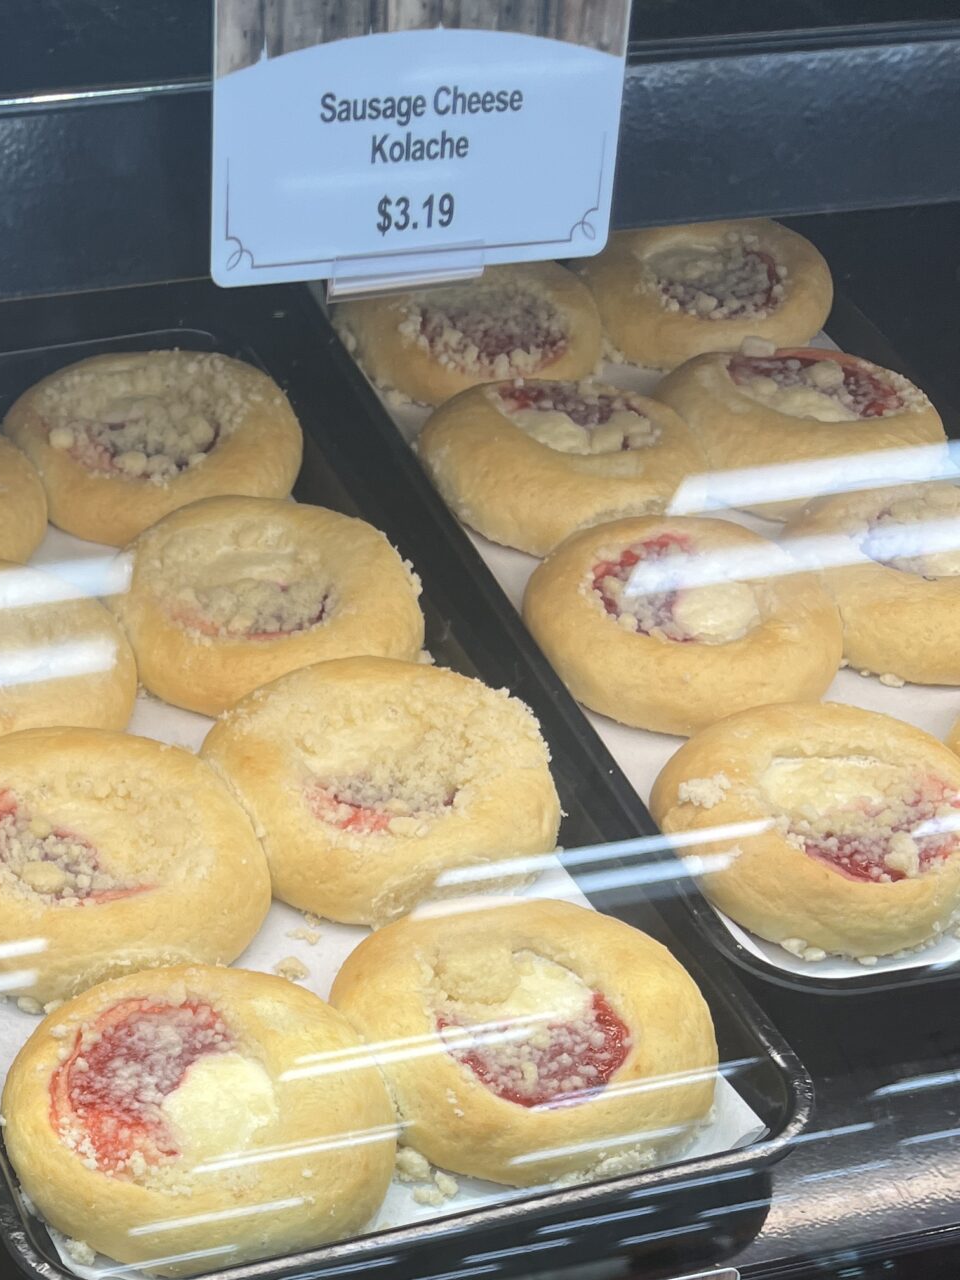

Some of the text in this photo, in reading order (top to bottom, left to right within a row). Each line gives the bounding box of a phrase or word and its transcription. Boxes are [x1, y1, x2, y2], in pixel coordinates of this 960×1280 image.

[320, 85, 524, 126] Sausage Cheese
[370, 131, 469, 164] Kolache
[376, 193, 455, 237] $3.19
